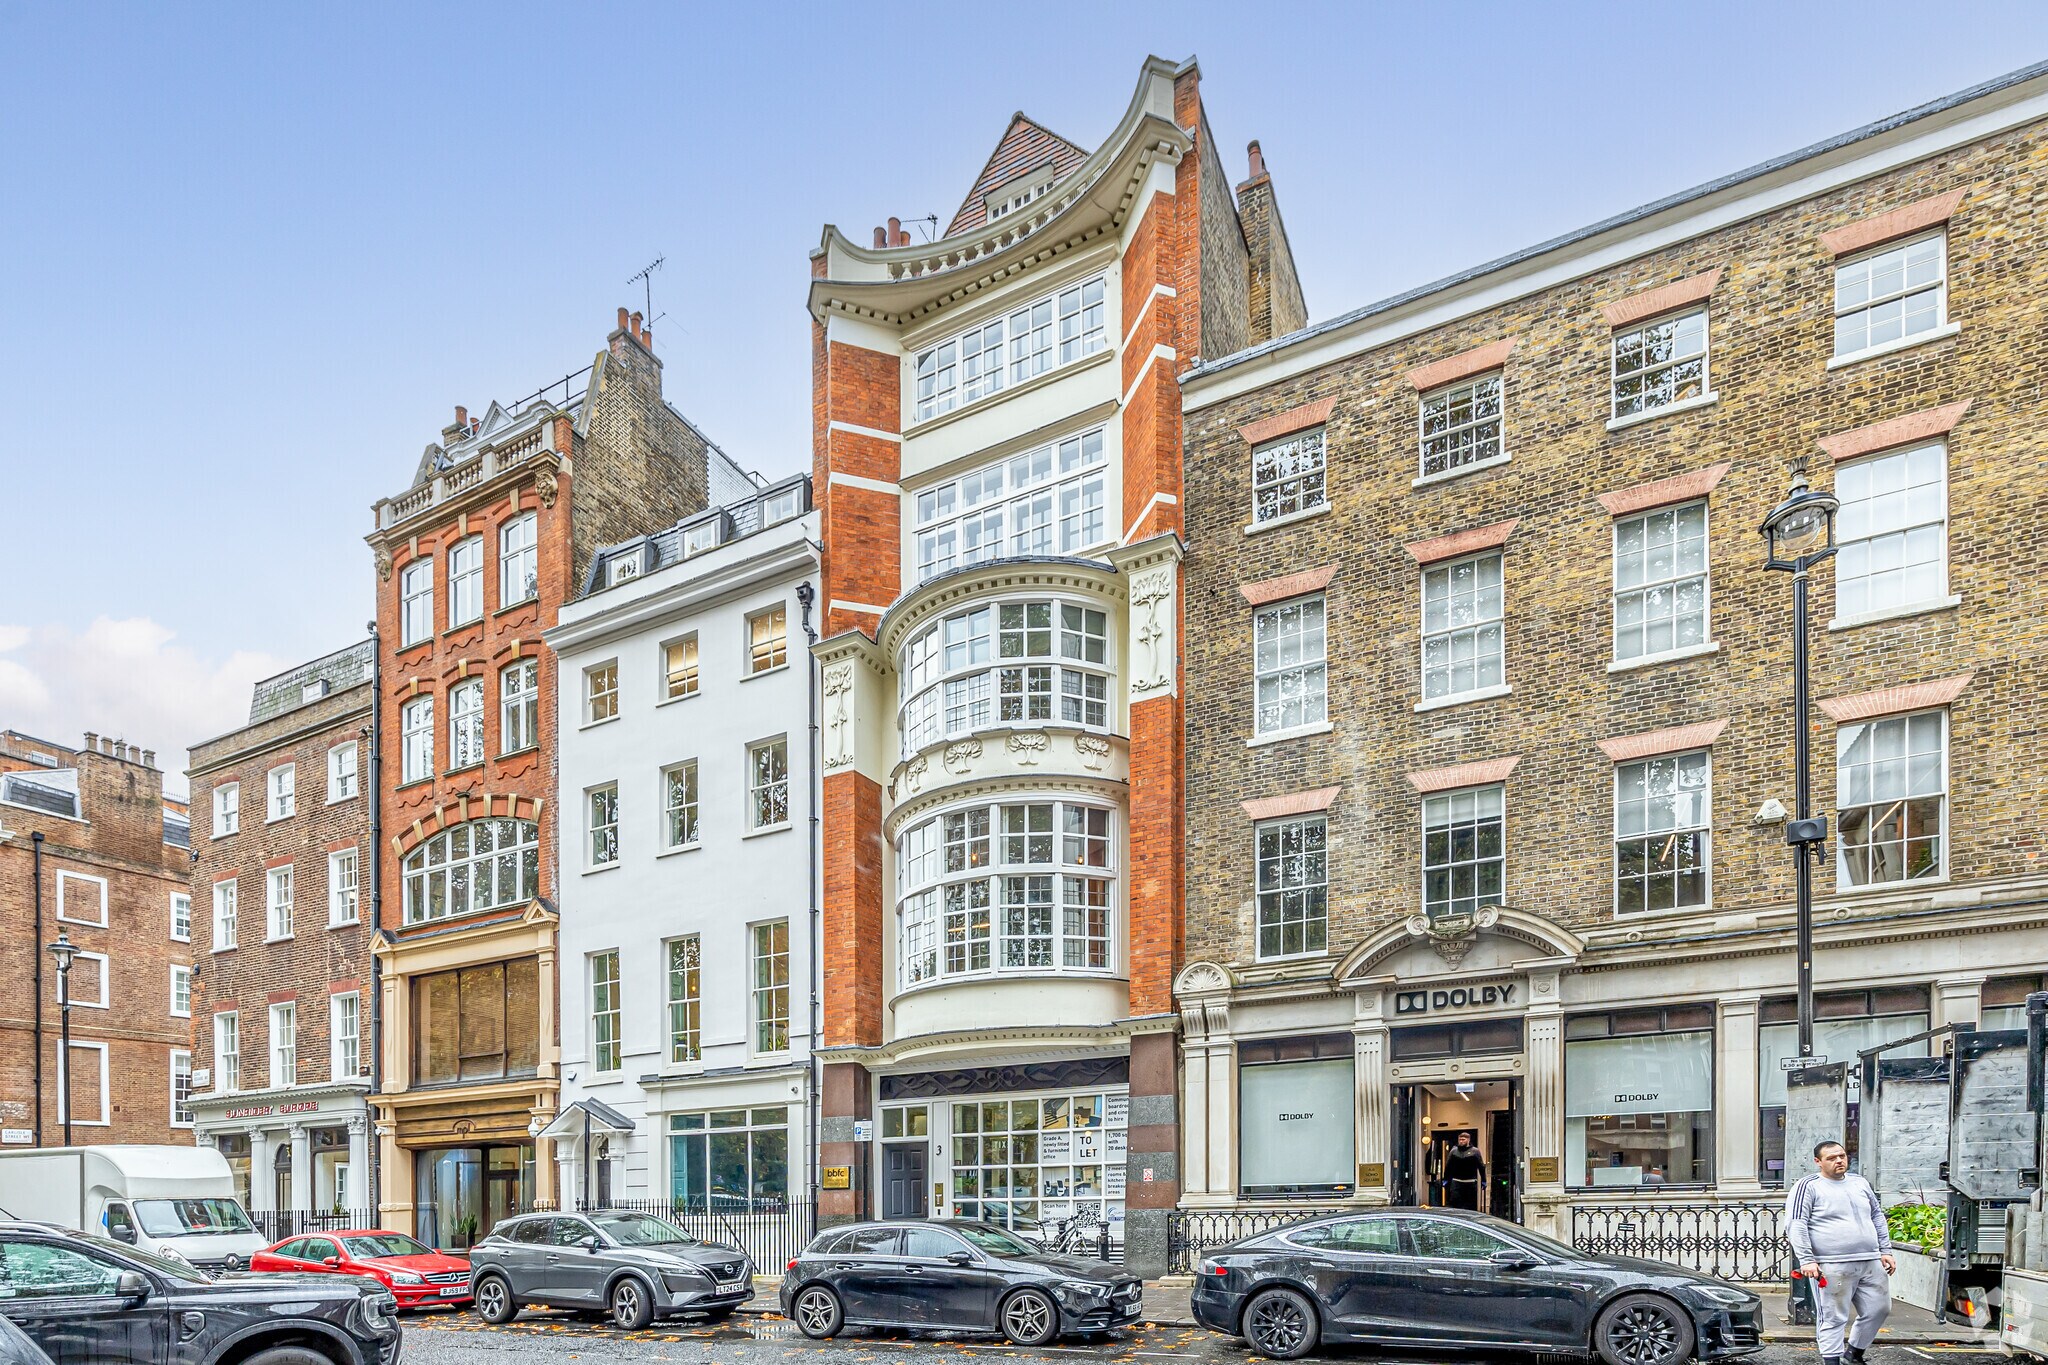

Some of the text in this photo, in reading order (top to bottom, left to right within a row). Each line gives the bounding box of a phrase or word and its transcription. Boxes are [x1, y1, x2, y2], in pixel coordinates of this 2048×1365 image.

[1432, 984, 1514, 1010] DOLBY
[1804, 1044, 1811, 1052] 3
[1629, 1093, 1659, 1101] DOLBY
[1080, 1136, 1092, 1145] TO
[936, 1145, 942, 1156] 3
[1080, 1149, 1097, 1158] LET
[827, 1169, 845, 1177] bbfc
